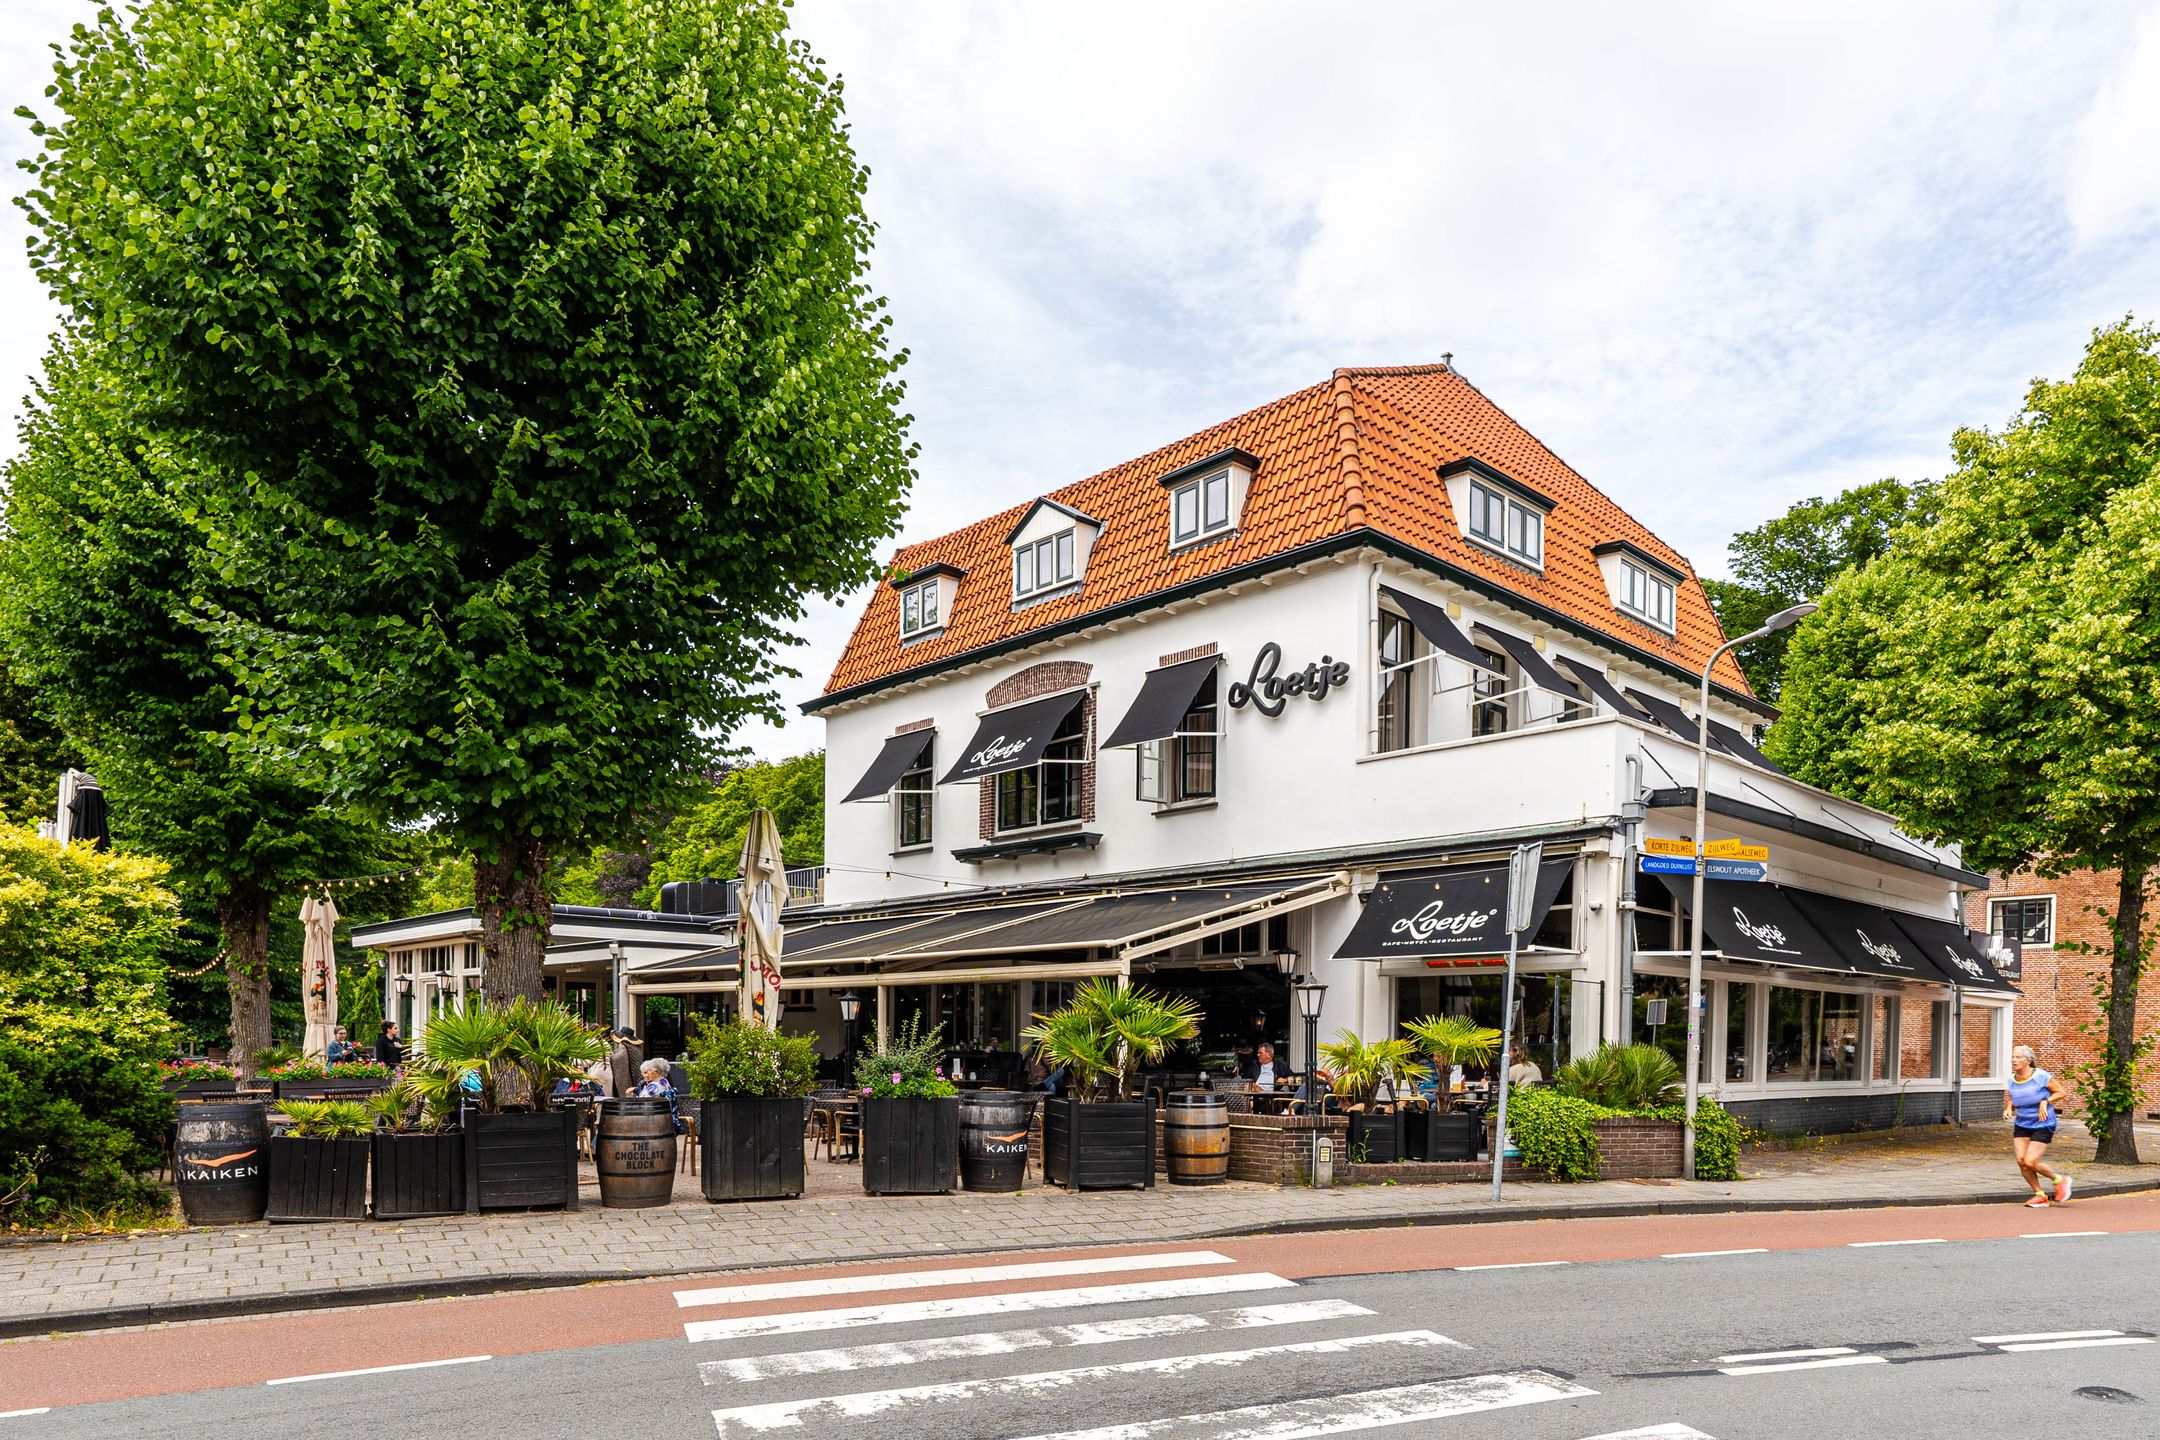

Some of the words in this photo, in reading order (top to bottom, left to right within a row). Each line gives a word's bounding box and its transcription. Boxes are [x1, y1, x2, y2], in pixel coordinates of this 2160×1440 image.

[1228, 641, 1350, 717] Loetje
[971, 735, 1027, 765] Loetje
[1651, 842, 1669, 851] KORTE
[1671, 843, 1693, 854] ZIJLWEG
[1708, 841, 1735, 853] ZIJLWEG
[1645, 861, 1669, 869] LANDGOED
[1707, 865, 1732, 874] ELSWOUT
[1734, 867, 1760, 876] APOTHEEK
[1391, 900, 1489, 940] Loetje
[632, 1142, 650, 1151] THE
[615, 1151, 665, 1161] CHOCOLATE
[626, 1160, 656, 1170] BLOCK
[187, 1166, 258, 1180] KAIKEN
